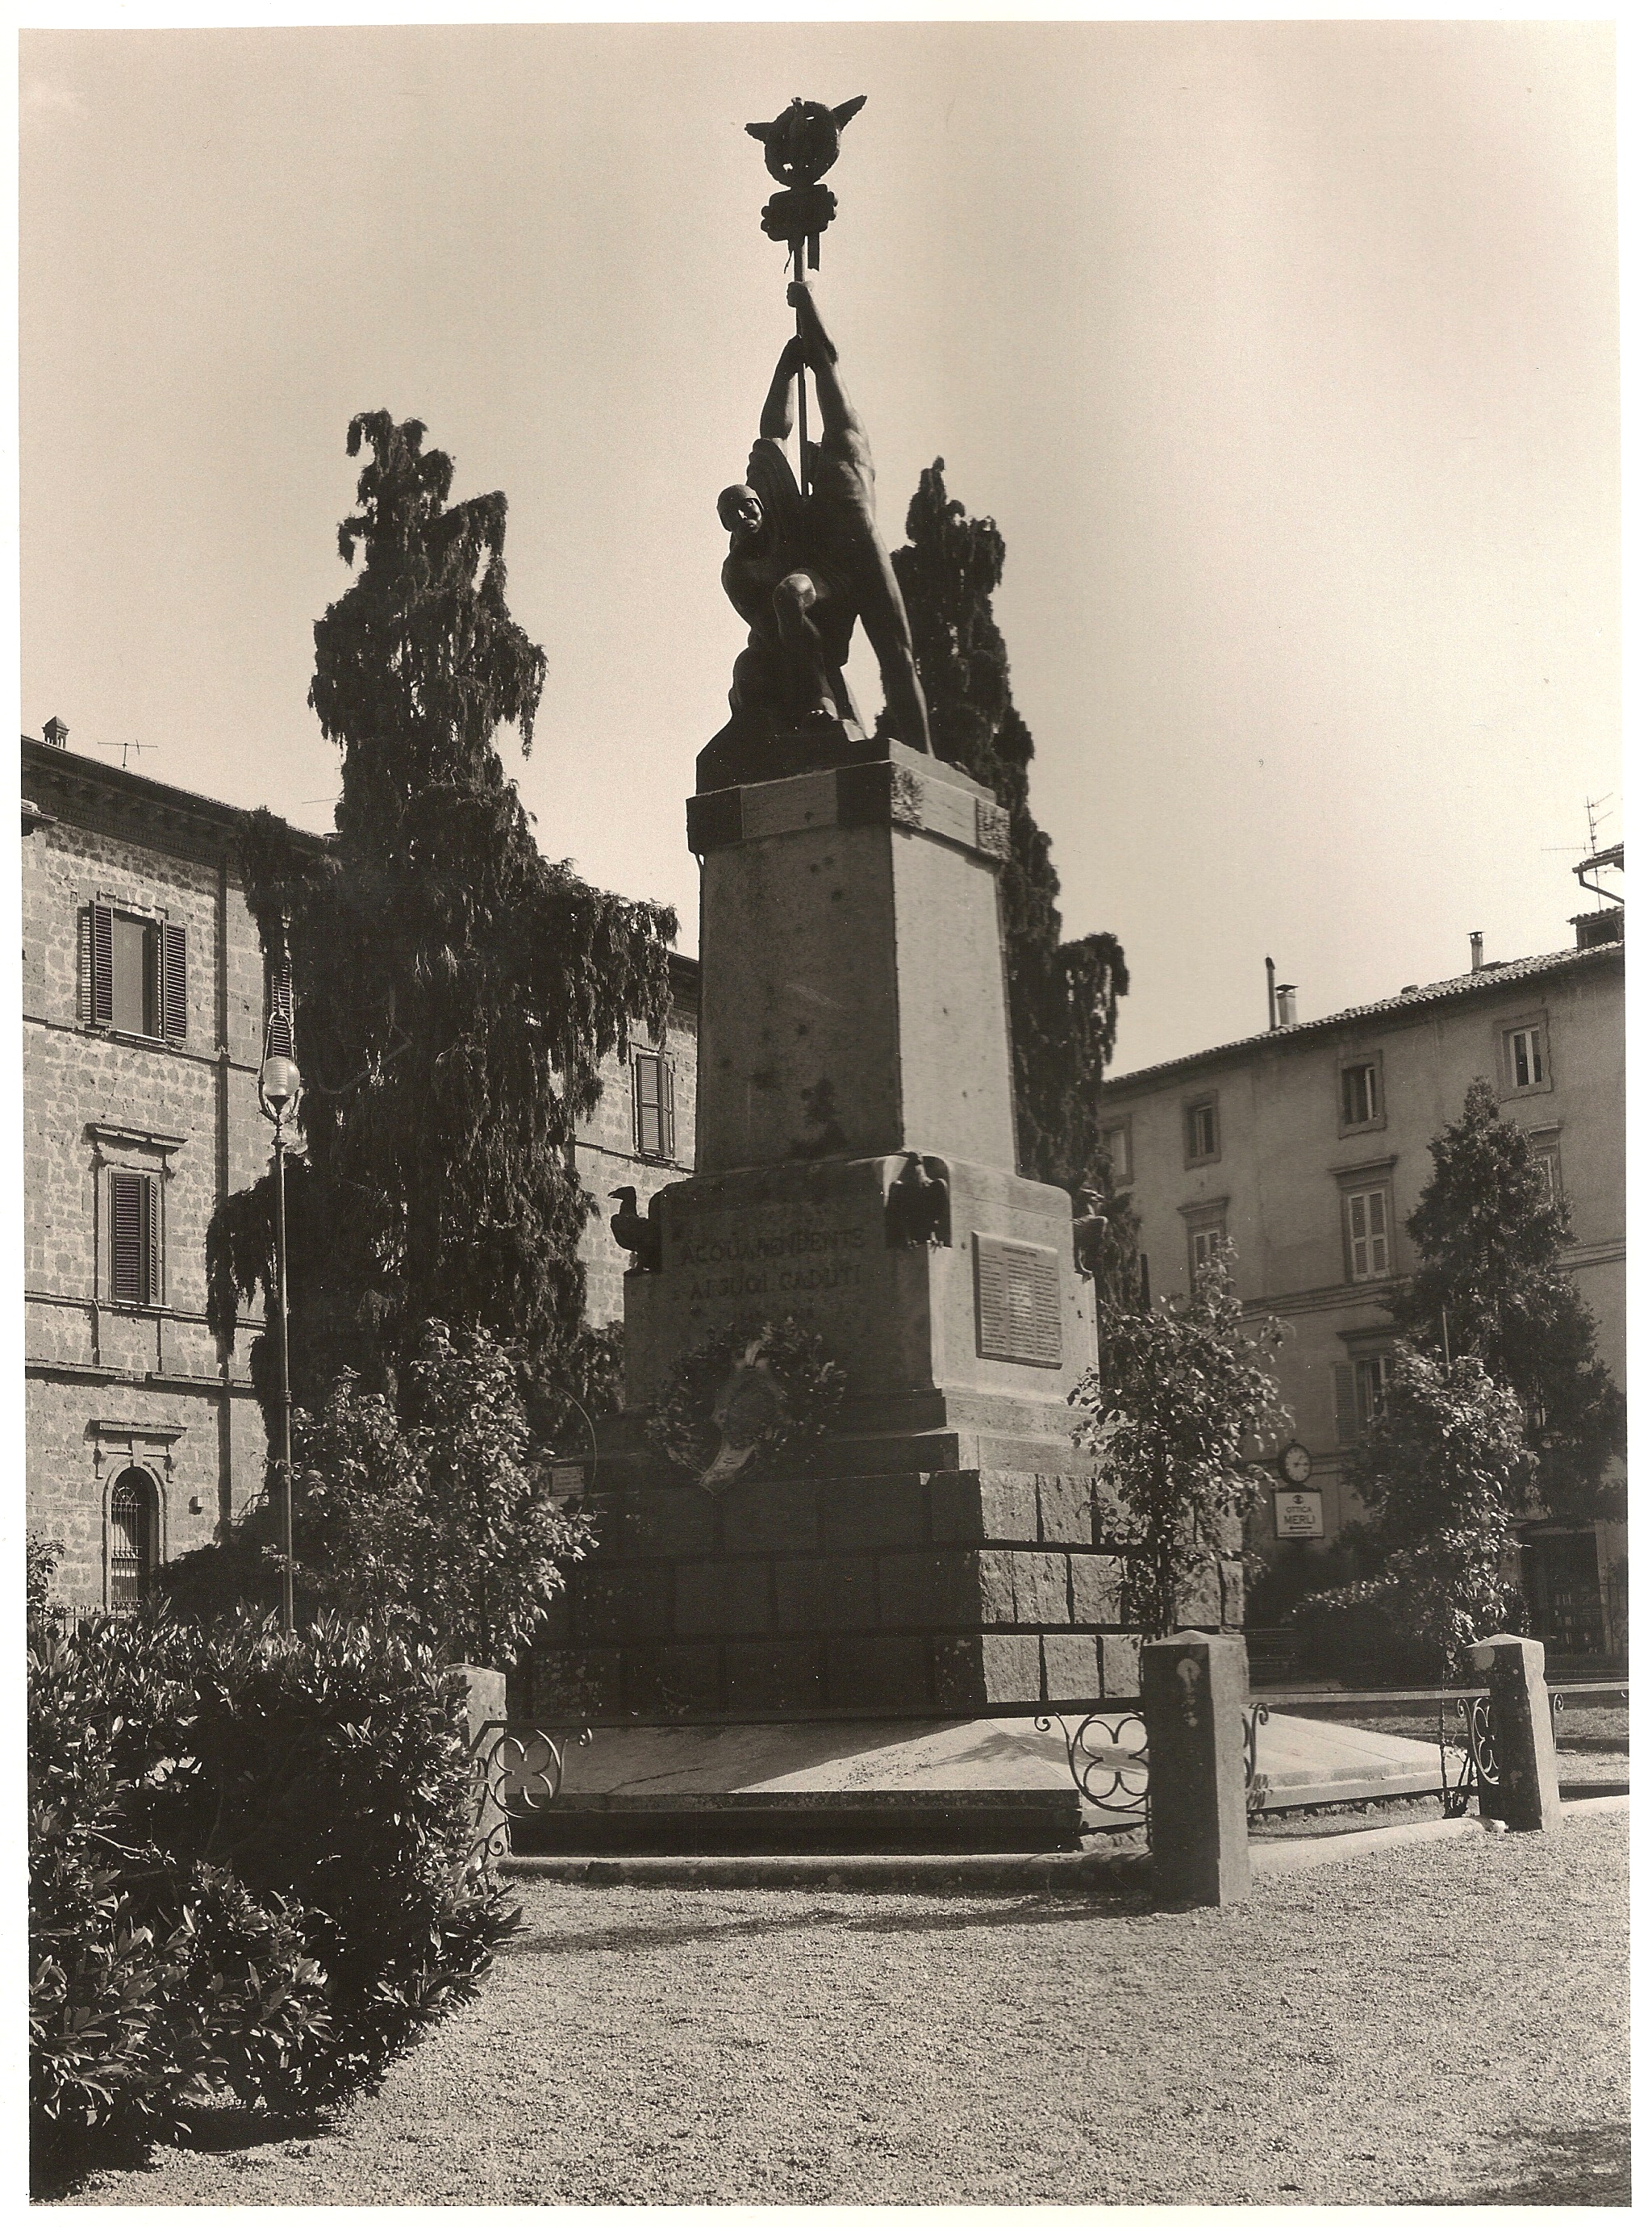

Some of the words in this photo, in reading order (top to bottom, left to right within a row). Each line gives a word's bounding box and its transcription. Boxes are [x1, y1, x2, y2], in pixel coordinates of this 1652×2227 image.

[779, 1264, 861, 1291] CADUTI
[1286, 1506, 1312, 1514] OTTICA
[1284, 1515, 1315, 1524] MERLI
